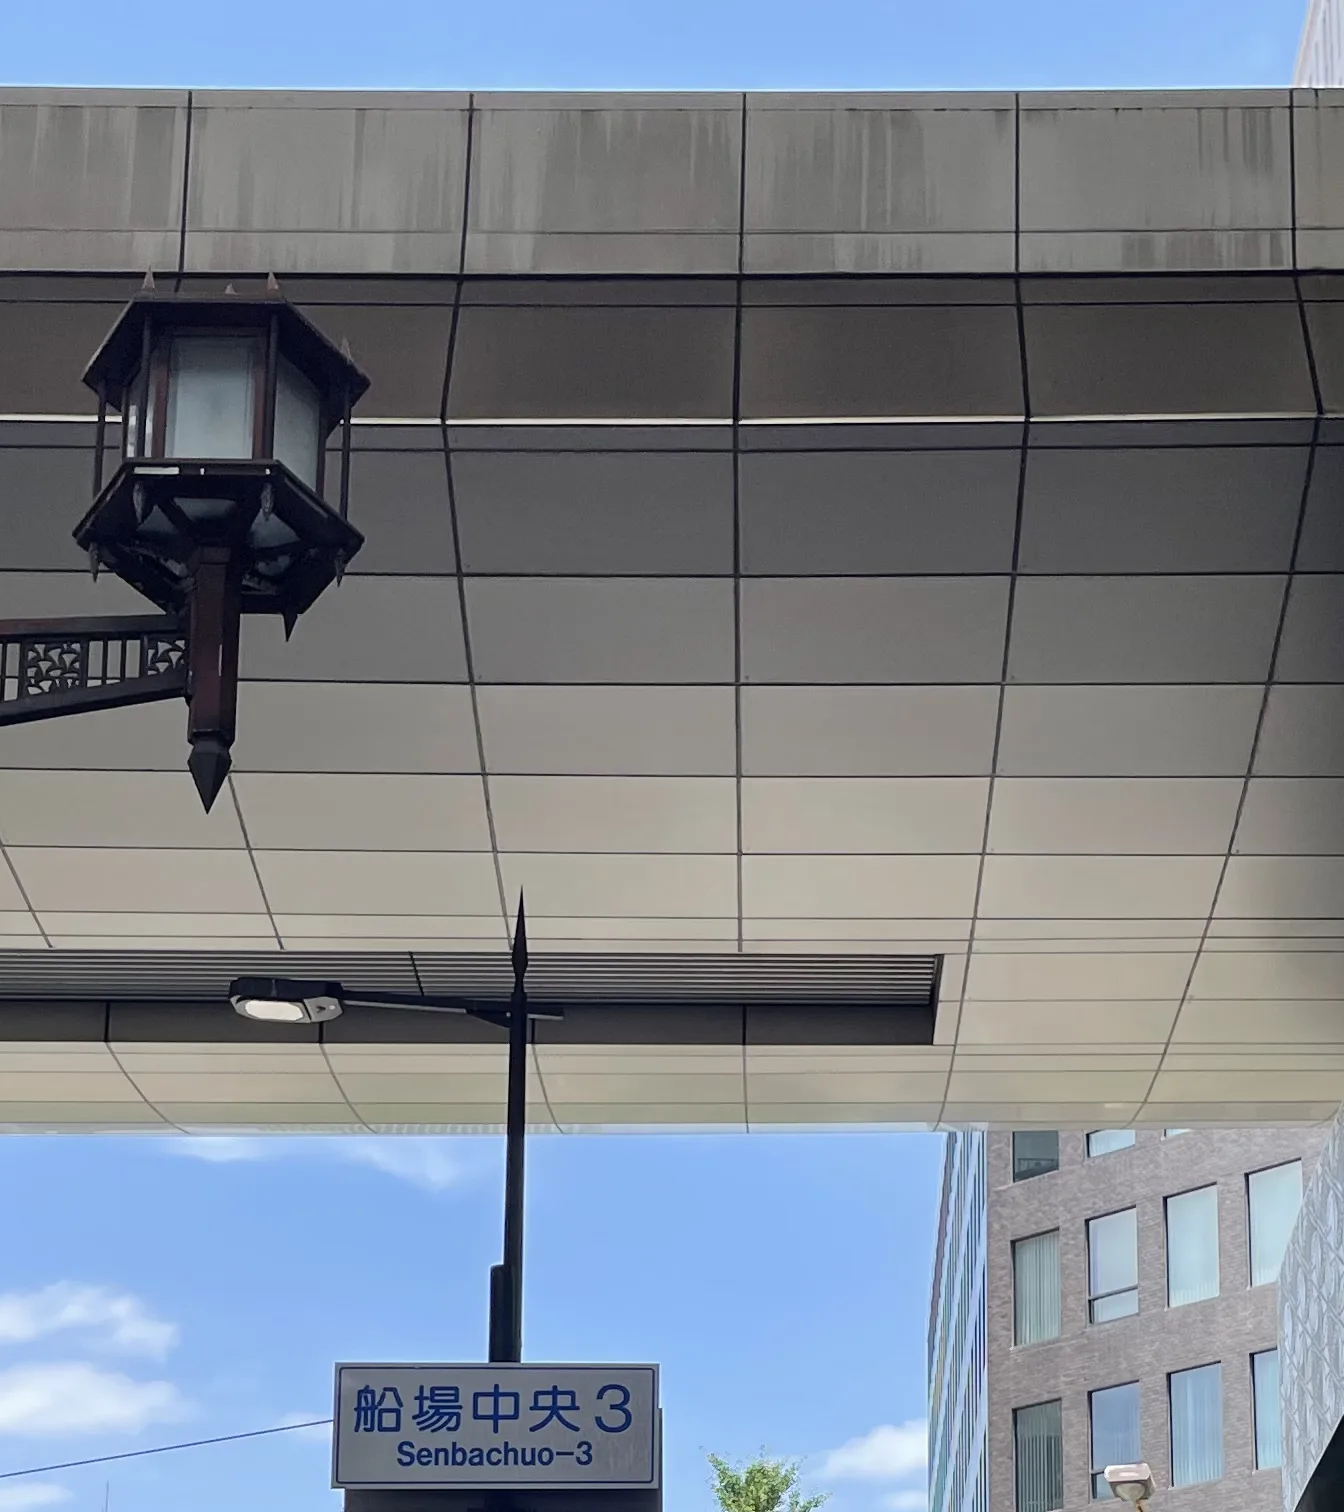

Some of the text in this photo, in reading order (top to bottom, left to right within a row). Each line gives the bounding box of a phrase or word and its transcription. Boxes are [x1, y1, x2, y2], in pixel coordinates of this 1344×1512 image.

[353, 1383, 633, 1434] 船場中央3
[396, 1440, 594, 1467] Senbachuo-3
